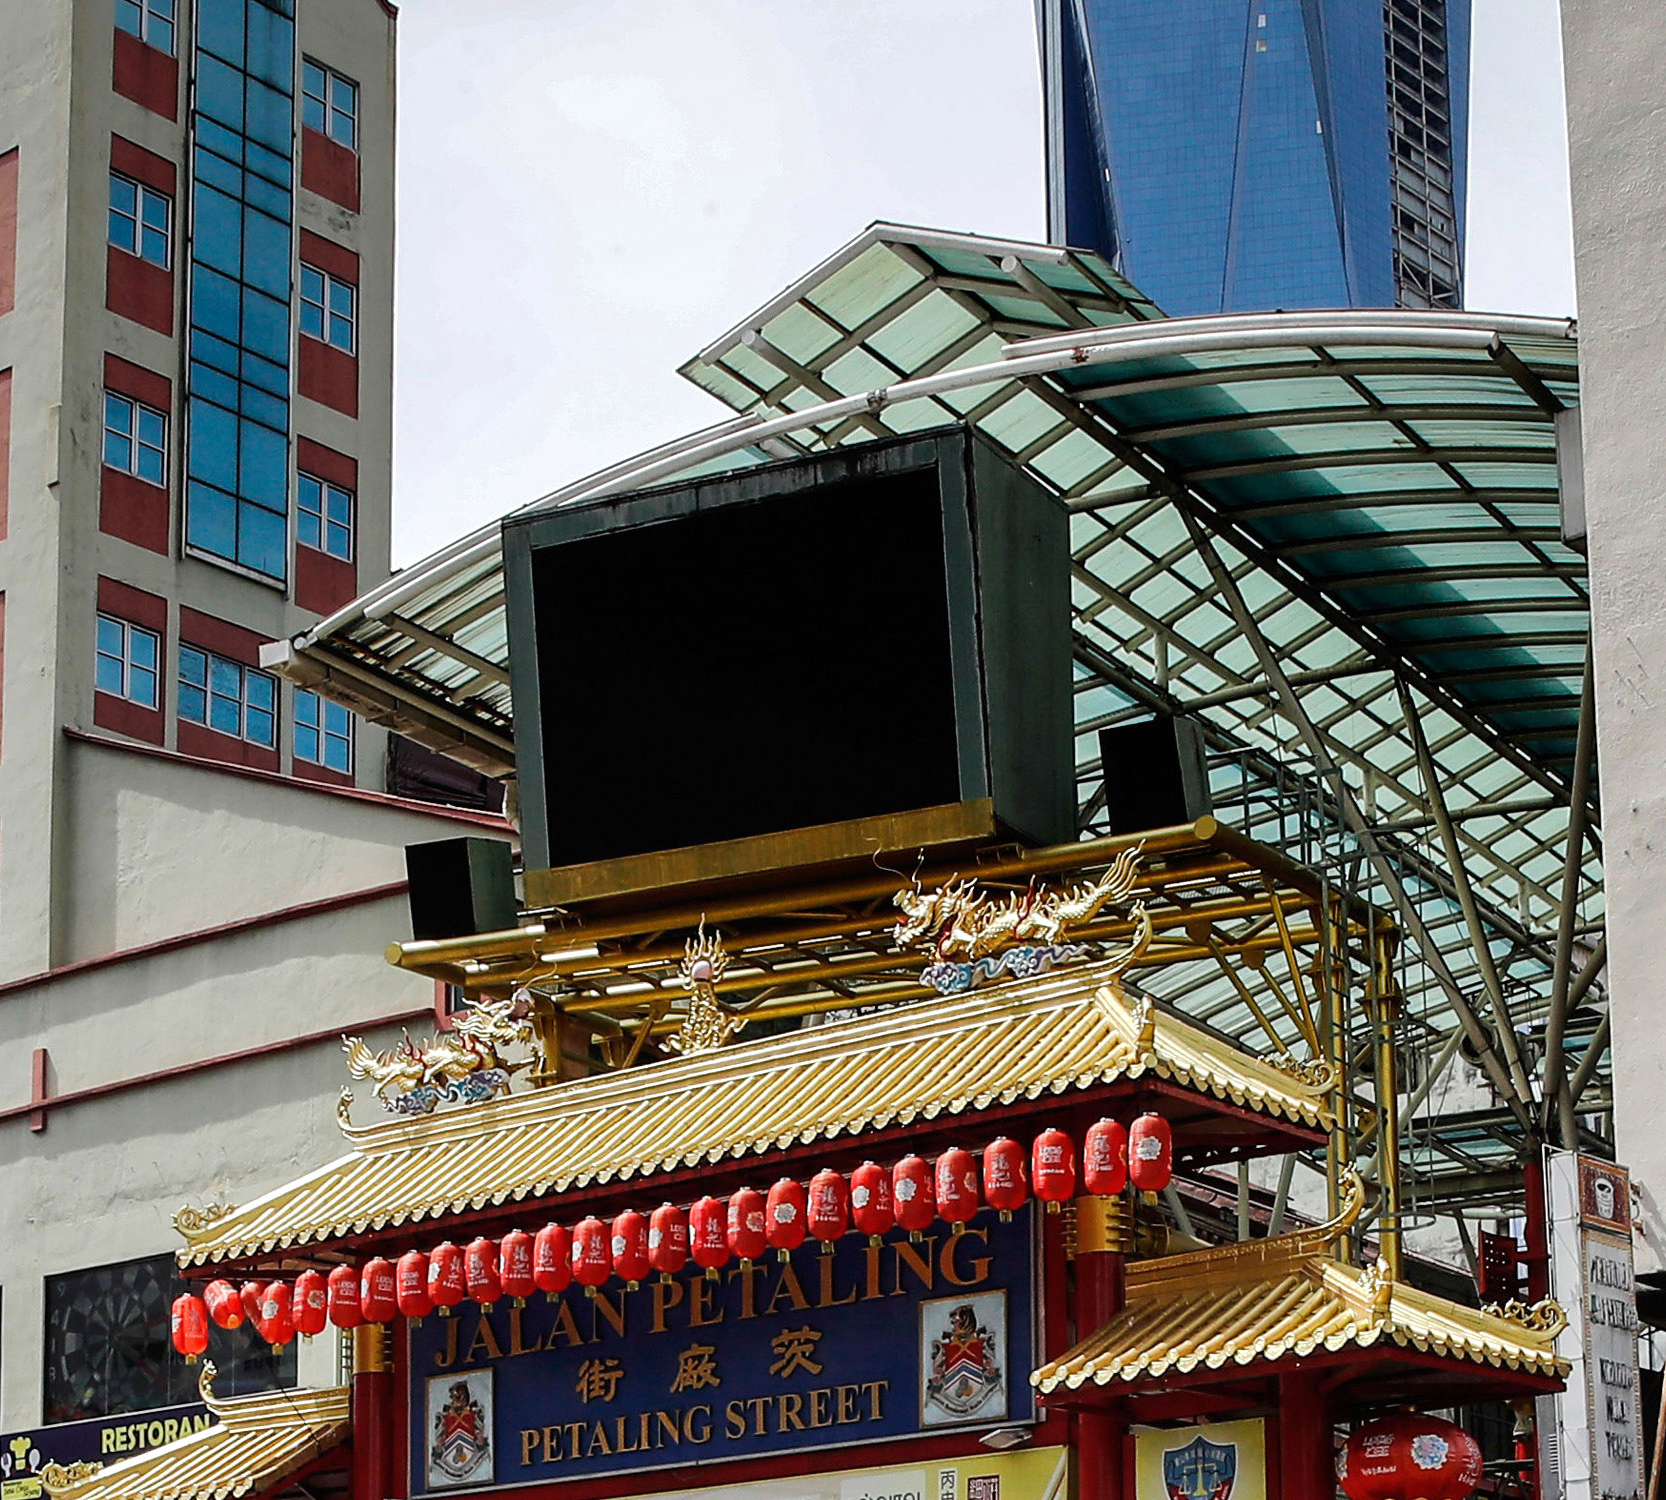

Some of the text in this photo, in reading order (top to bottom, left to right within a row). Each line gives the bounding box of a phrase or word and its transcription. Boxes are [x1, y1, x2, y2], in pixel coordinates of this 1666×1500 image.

[435, 1227, 994, 1368] JALAN PETALING
[101, 1414, 211, 1454] RESTORAN
[520, 1380, 890, 1466] PETALING STREET
